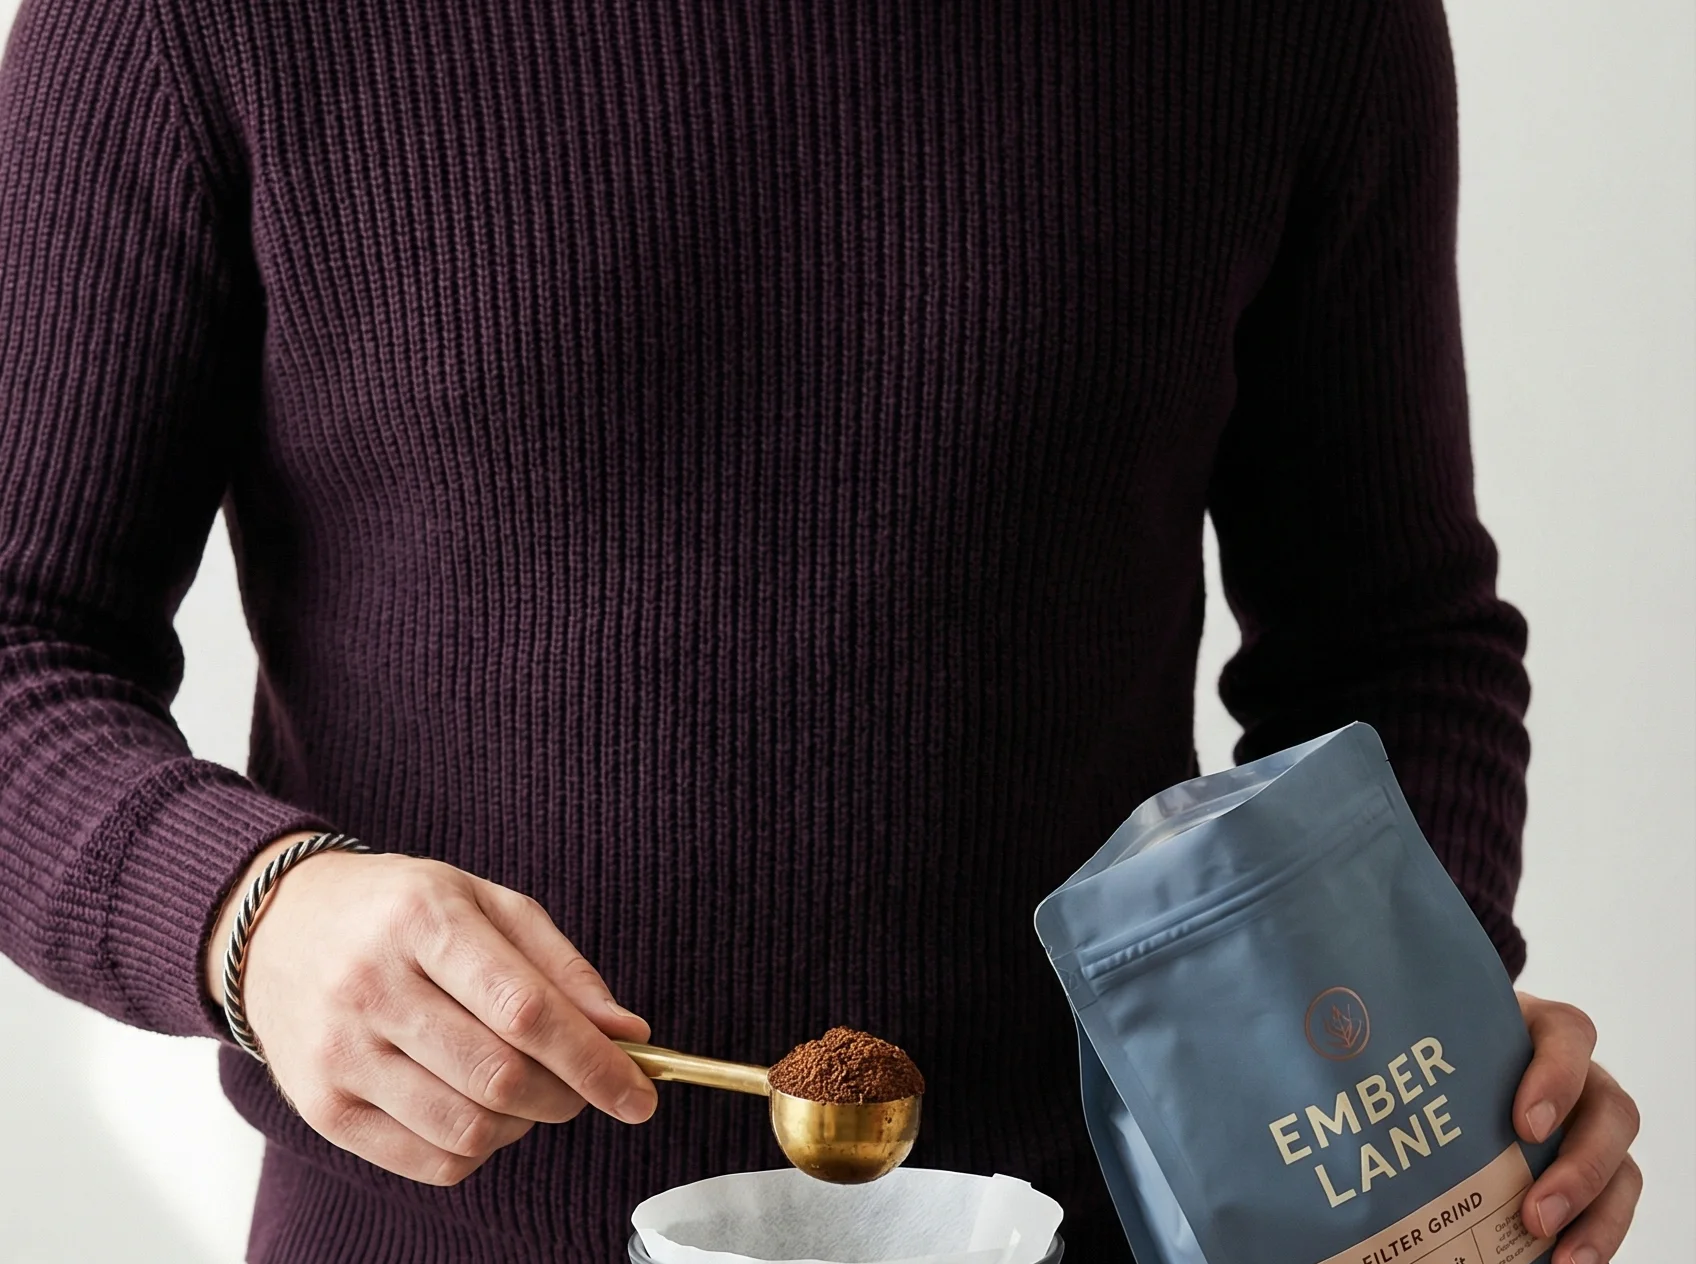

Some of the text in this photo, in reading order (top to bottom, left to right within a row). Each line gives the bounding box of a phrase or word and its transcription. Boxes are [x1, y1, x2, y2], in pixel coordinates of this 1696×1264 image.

[1269, 1036, 1456, 1165] EMBER
[1314, 1094, 1462, 1208] LANE
[1428, 1191, 1483, 1234] GRIND
